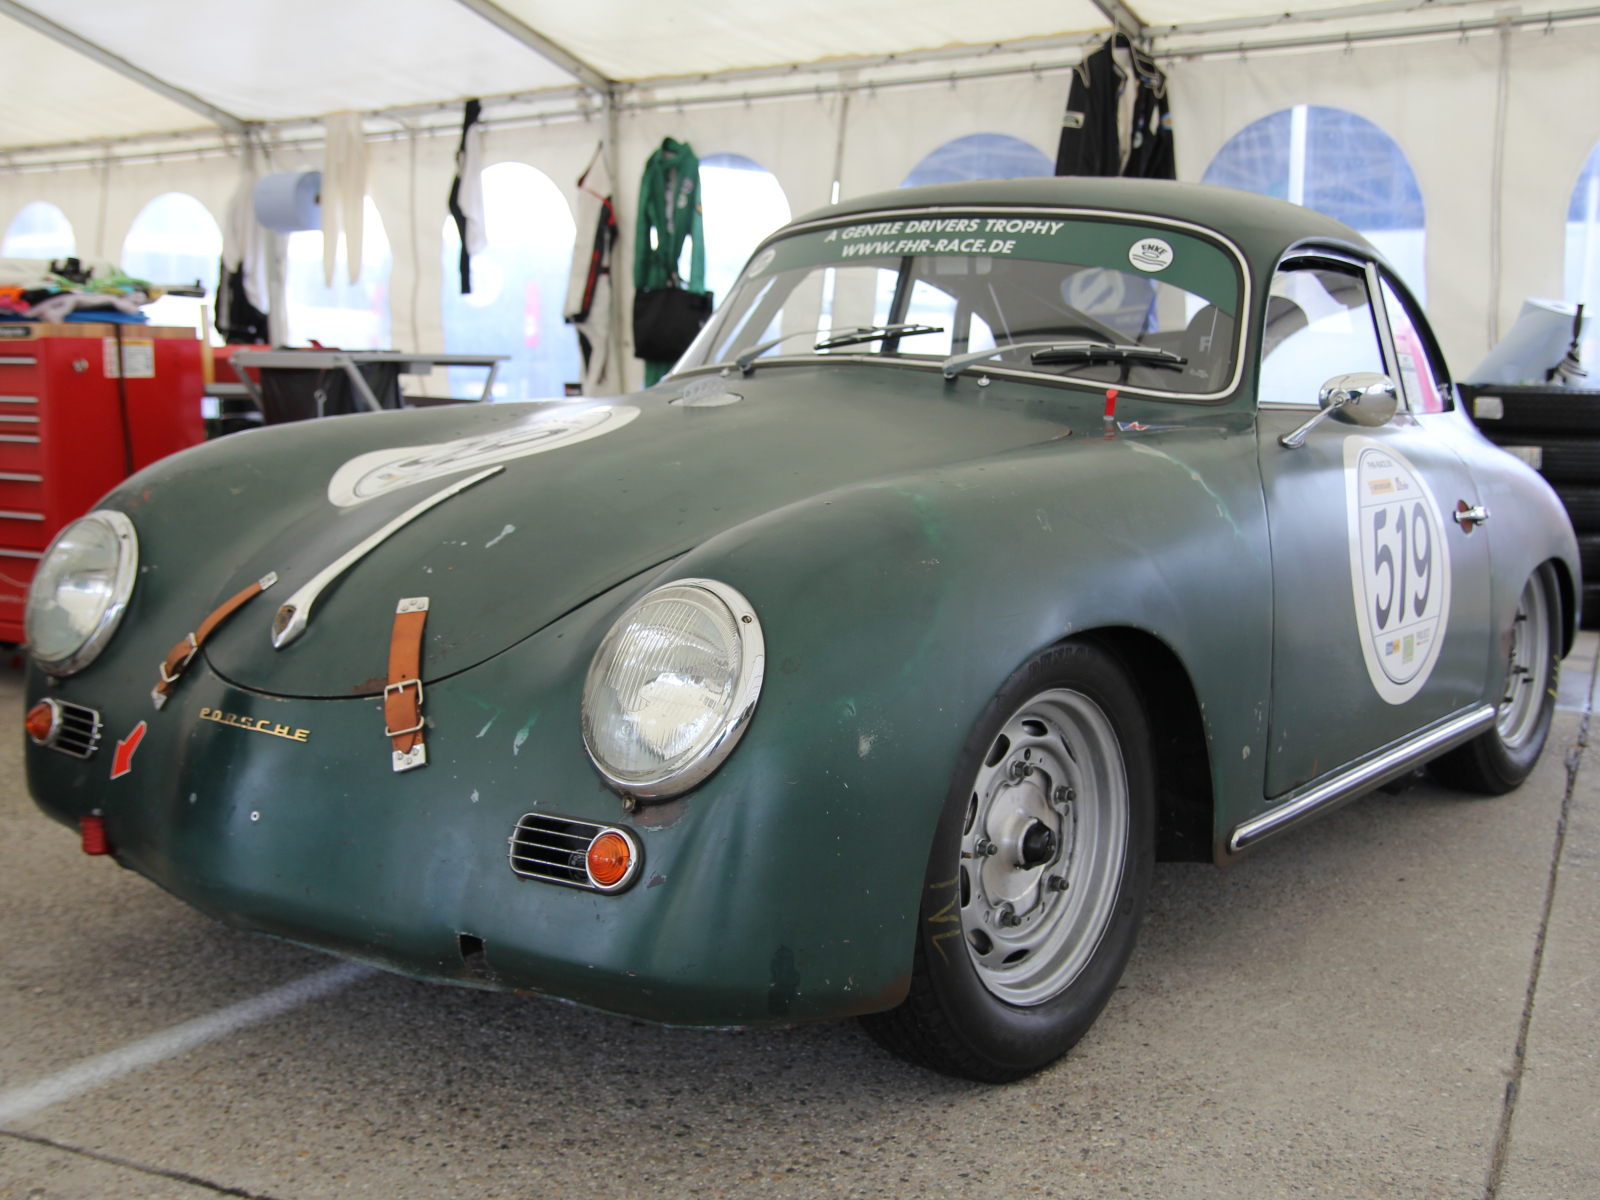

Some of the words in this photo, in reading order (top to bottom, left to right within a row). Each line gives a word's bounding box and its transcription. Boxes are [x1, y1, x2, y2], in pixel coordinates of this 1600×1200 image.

[824, 229, 838, 243] A
[841, 222, 903, 240] GENTLE
[904, 219, 980, 234] DRIVERS
[984, 219, 1065, 235] TROPHY
[841, 239, 1016, 258] WWW.FHR-RACE.DE
[1141, 243, 1168, 256] ENKE
[1373, 501, 1433, 631] 519
[199, 706, 311, 742] PORSCHE
